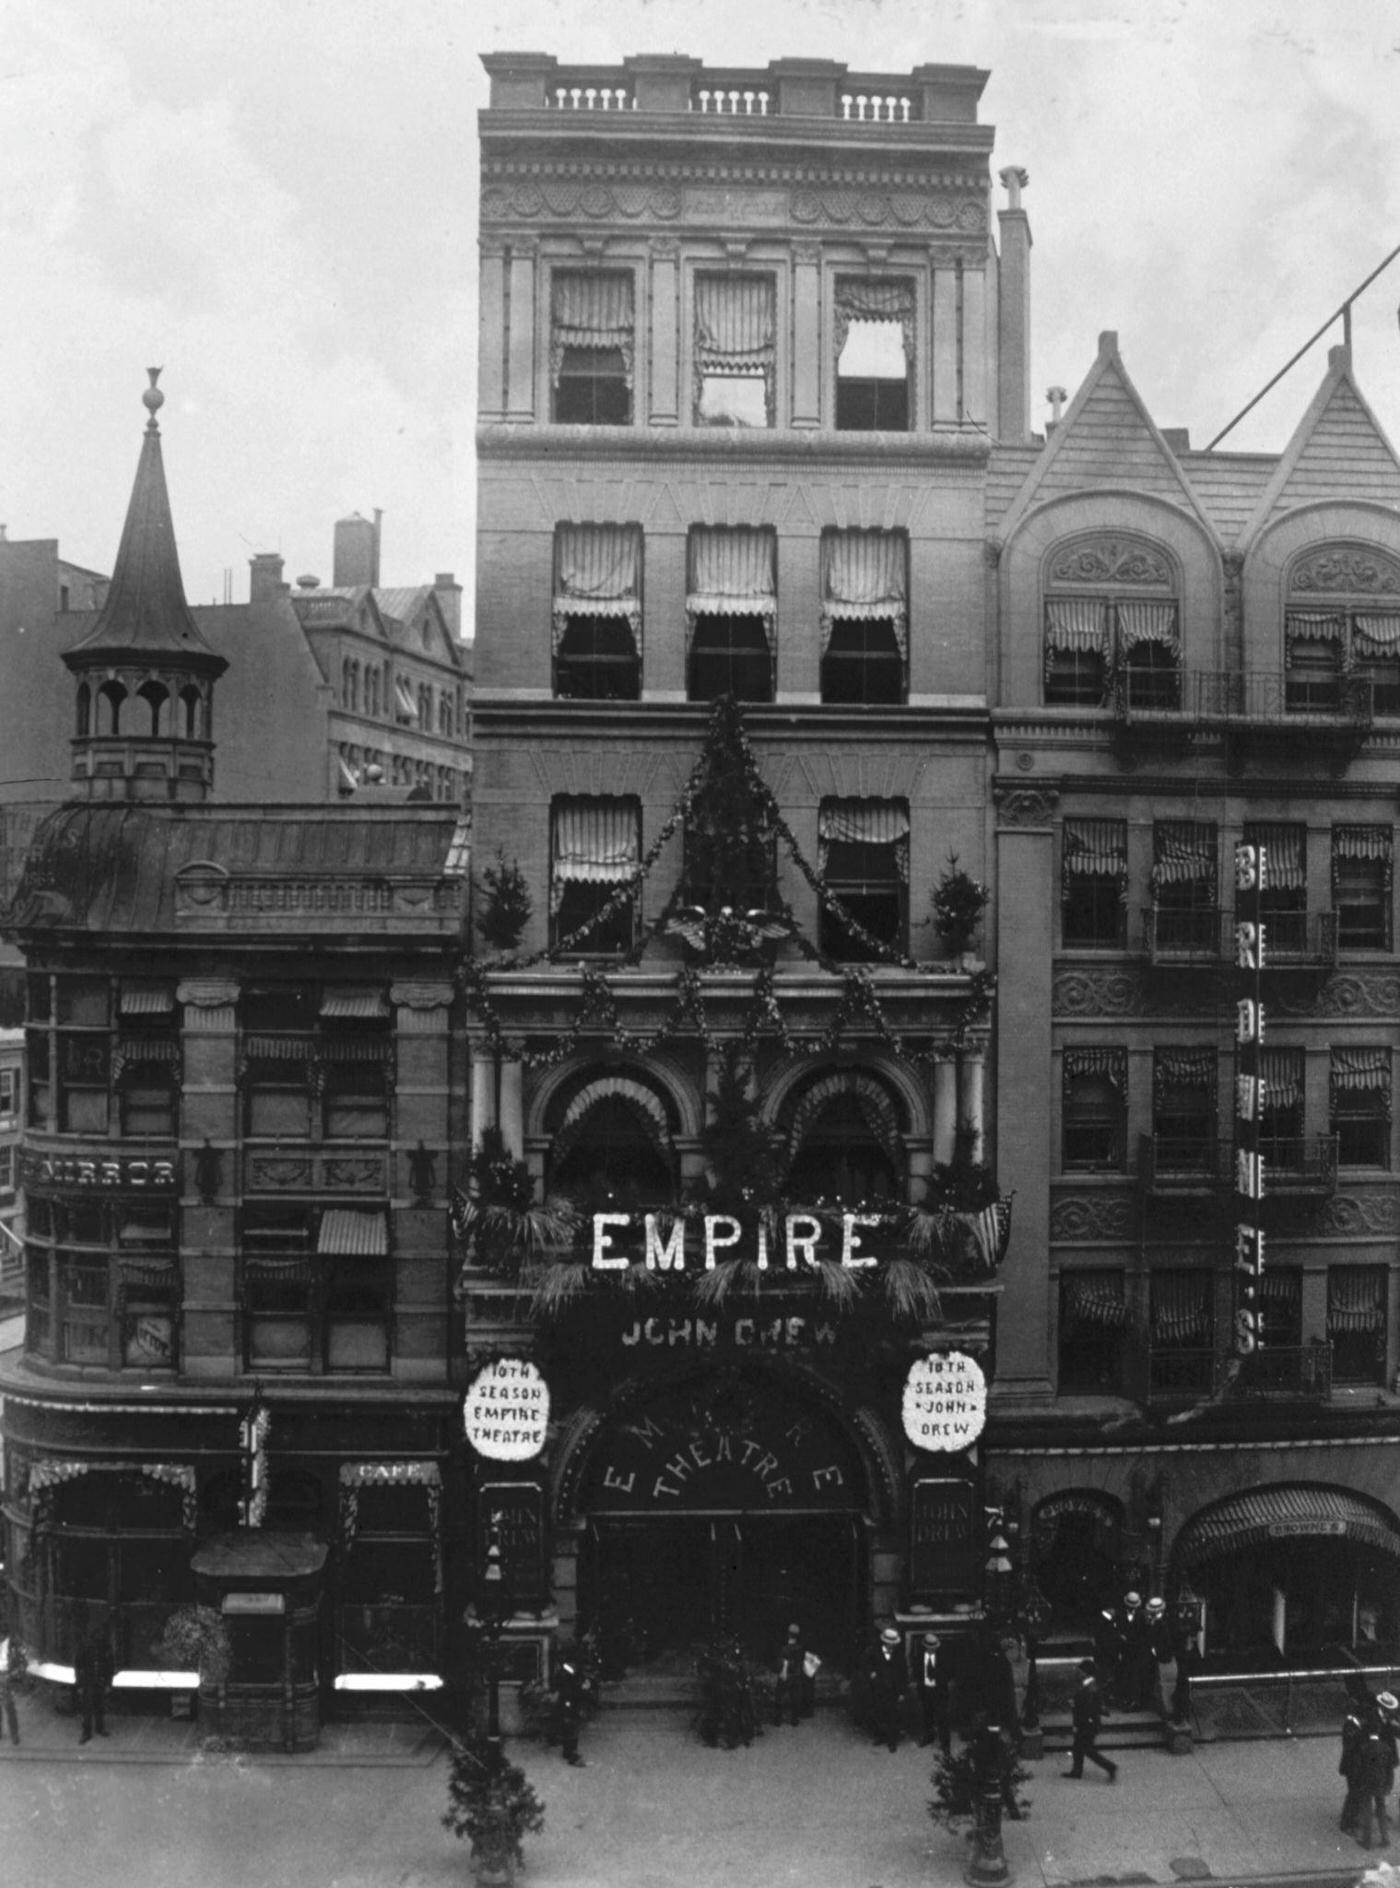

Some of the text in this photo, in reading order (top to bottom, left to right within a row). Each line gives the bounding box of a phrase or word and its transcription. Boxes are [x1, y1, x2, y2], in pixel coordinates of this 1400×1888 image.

[38, 1160, 175, 1184] MIRROR
[592, 1213, 880, 1270] EMPIRE
[622, 1317, 717, 1346] JOHN
[492, 1366, 529, 1378] 10TH
[929, 1361, 965, 1373] 10TH
[479, 1385, 541, 1400] SEASON
[915, 1380, 974, 1394] SEASON
[474, 1406, 540, 1421] EMPIRE
[473, 1427, 541, 1443] THEATRE
[921, 1422, 969, 1436] DREW
[653, 1435, 794, 1498] THEATRE
